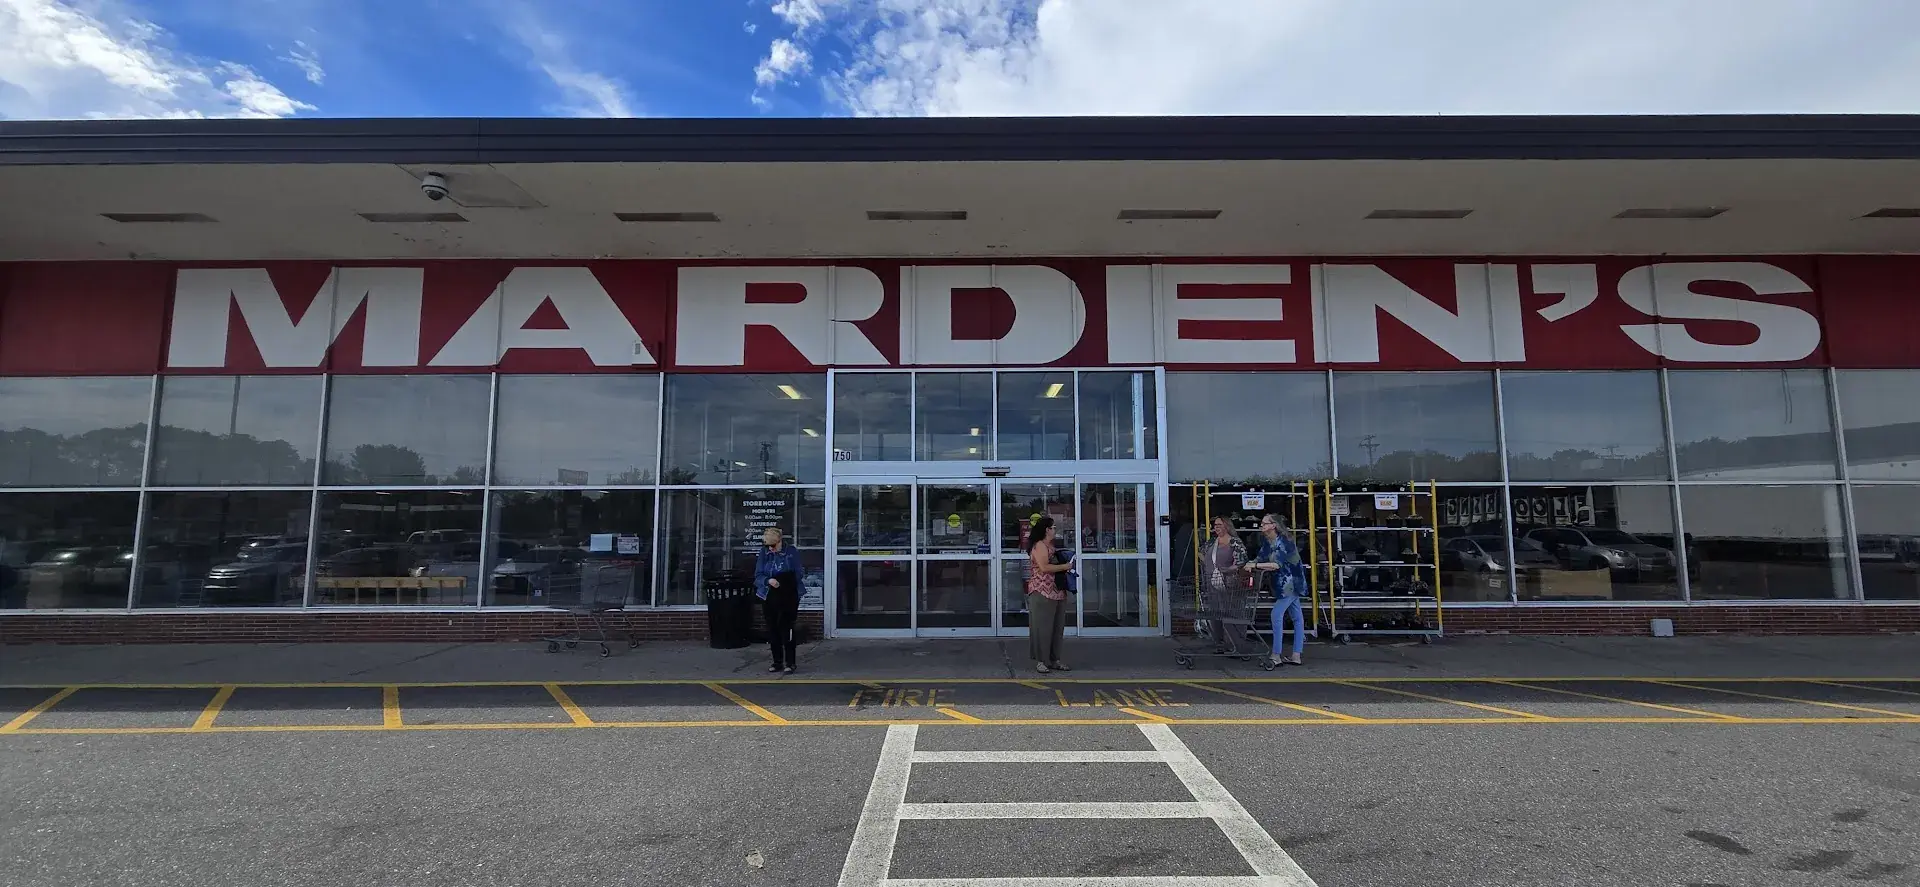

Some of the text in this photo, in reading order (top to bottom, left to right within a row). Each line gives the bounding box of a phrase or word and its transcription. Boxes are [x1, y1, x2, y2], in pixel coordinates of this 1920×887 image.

[167, 262, 1822, 367] MARDEN'S
[834, 451, 851, 461] 750
[848, 689, 1191, 707] FIRE LANE
